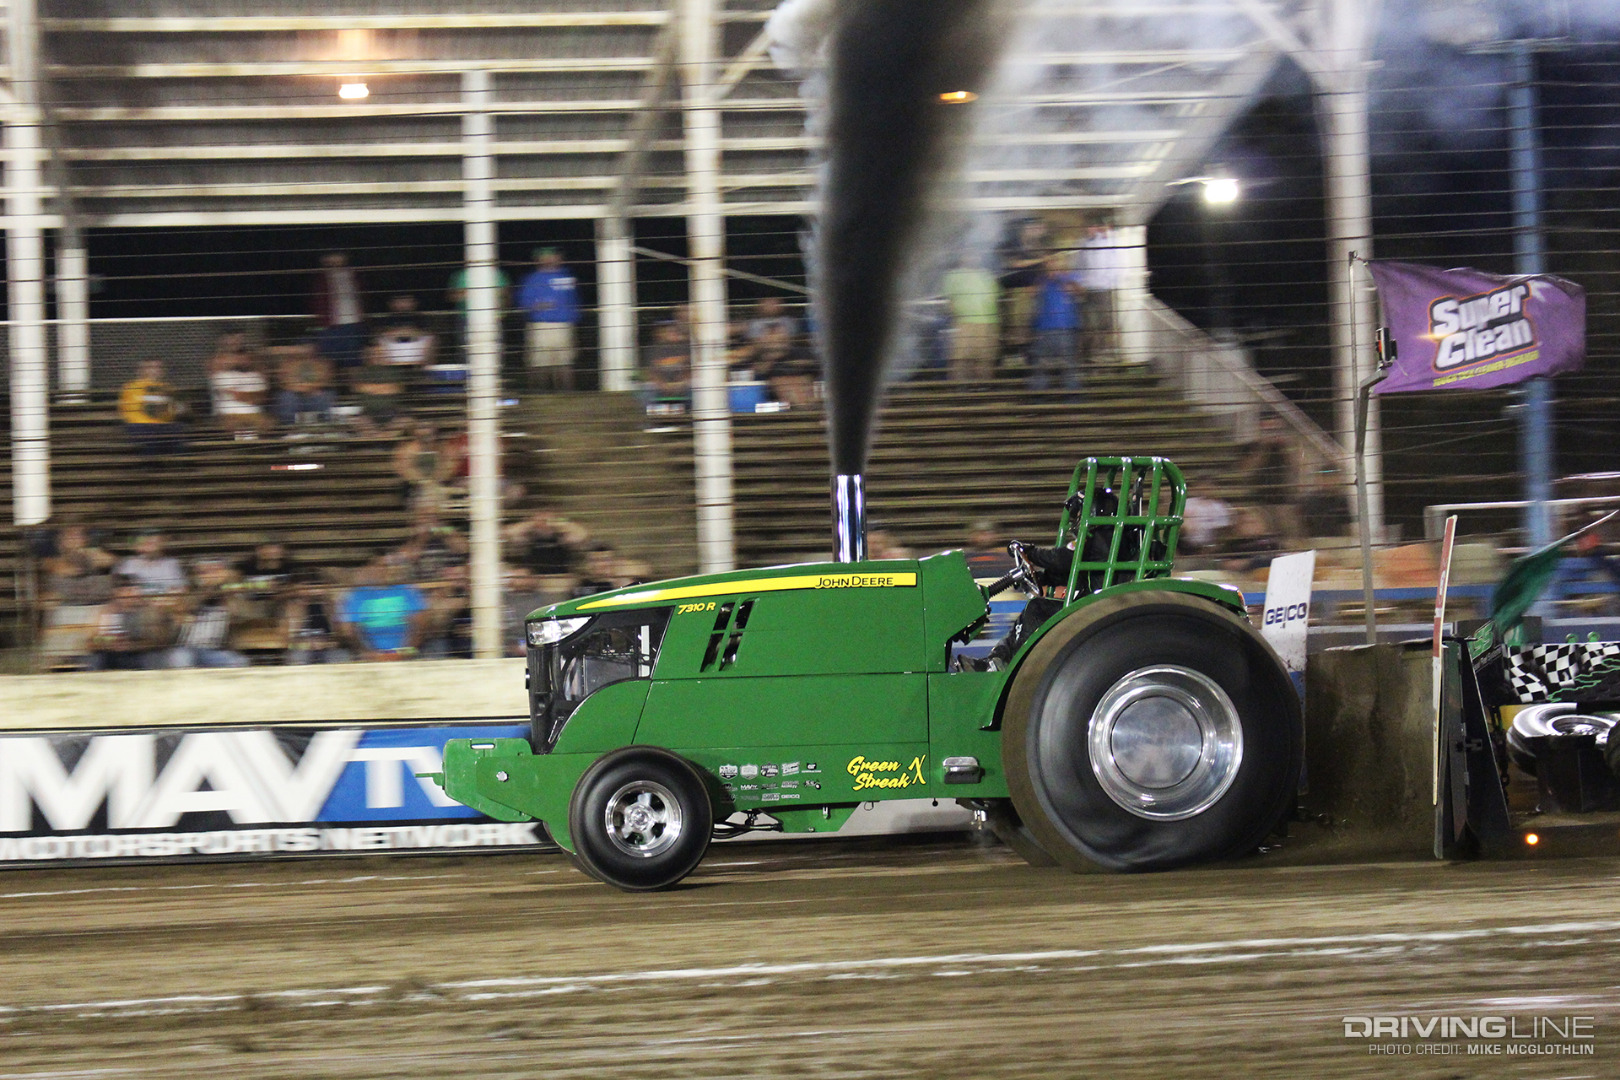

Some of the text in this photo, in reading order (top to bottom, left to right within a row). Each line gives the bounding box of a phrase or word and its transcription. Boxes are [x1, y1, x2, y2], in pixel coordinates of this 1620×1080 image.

[1432, 285, 1527, 334] Super
[1435, 319, 1533, 369] Clean
[815, 576, 893, 587] JOHN DEERE
[677, 602, 716, 615] 7310 R
[1265, 602, 1307, 625] GEICO
[846, 755, 902, 776] Green
[852, 754, 926, 791] Streak X
[321, 822, 542, 850] NETWORK
